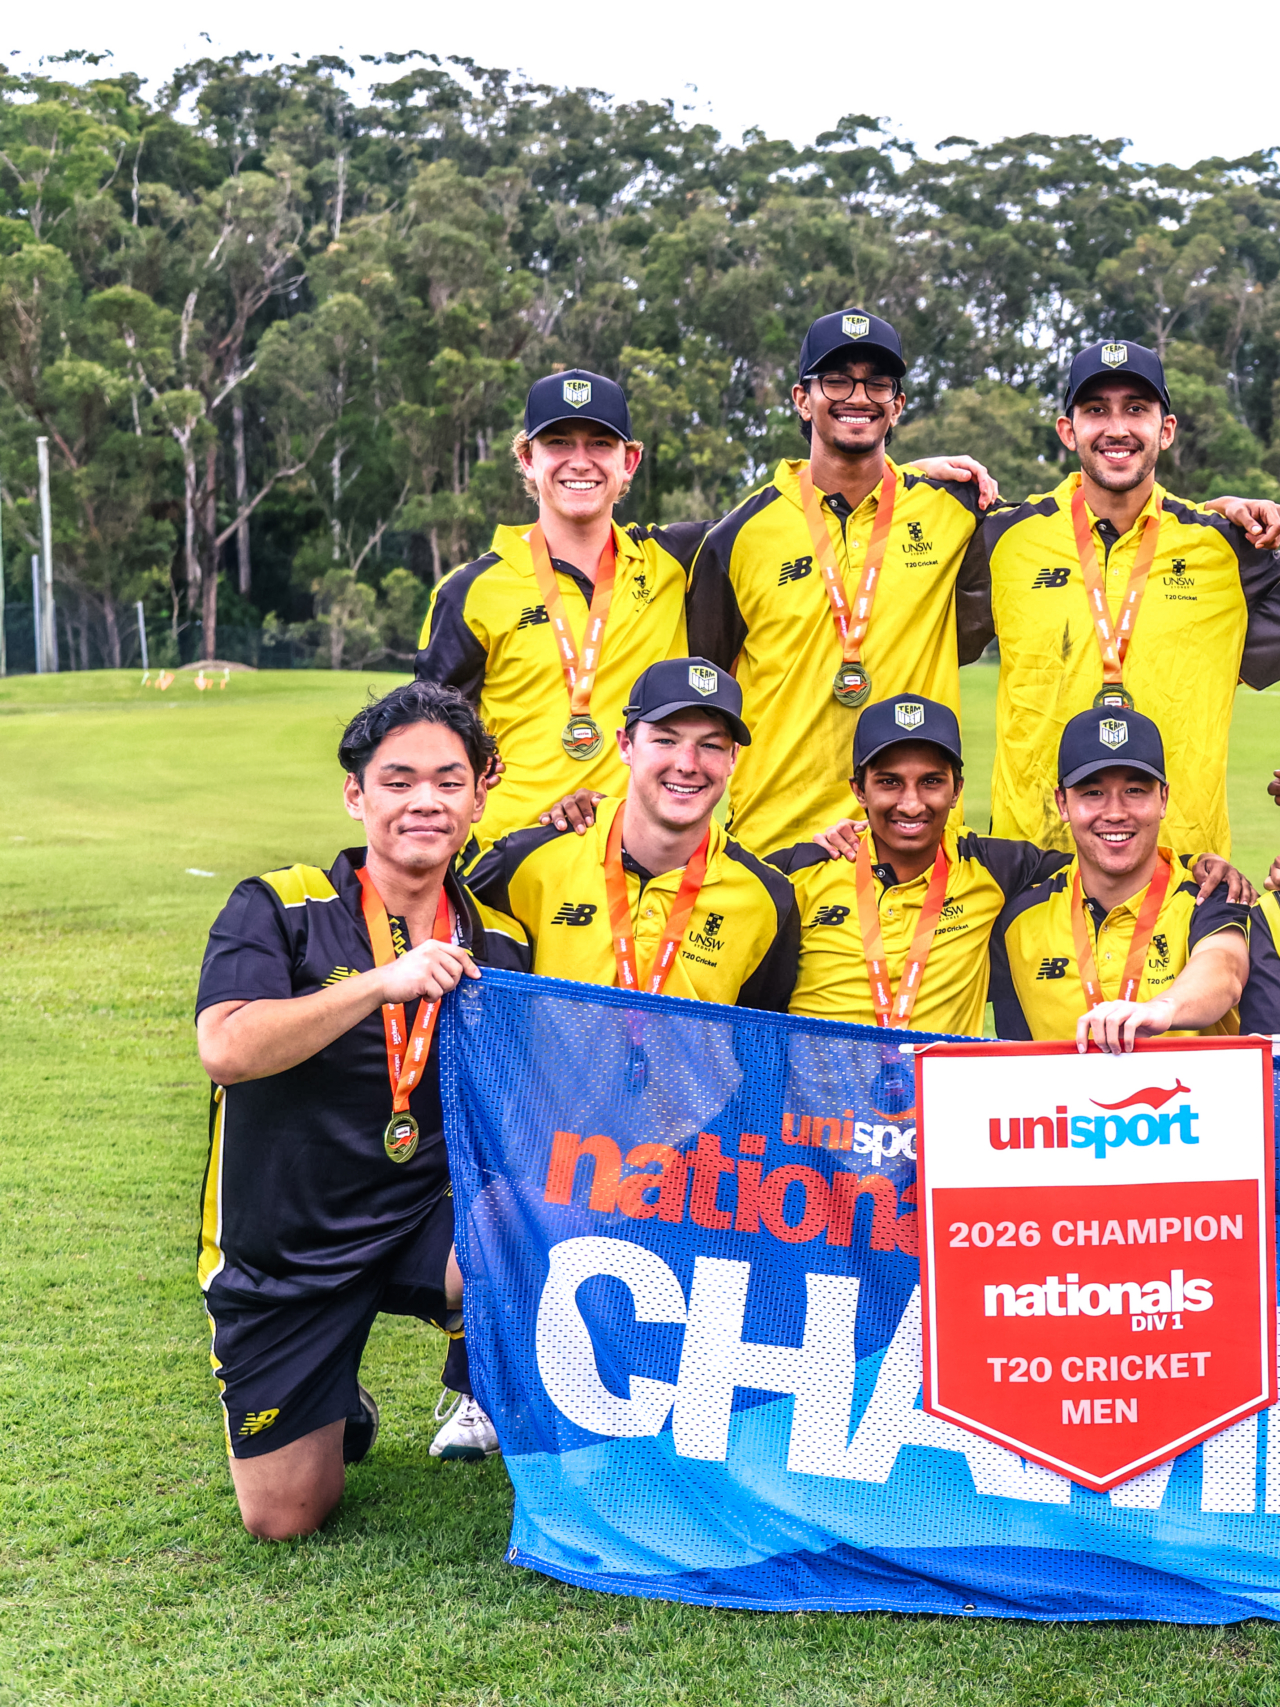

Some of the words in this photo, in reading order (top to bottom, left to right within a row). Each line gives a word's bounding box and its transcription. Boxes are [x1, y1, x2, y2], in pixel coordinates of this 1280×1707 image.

[1105, 343, 1124, 352] TEAM
[567, 382, 588, 391] TEAM
[902, 541, 933, 554] UNSW
[1163, 577, 1195, 586] UNSW
[692, 668, 715, 678] TEAM
[899, 705, 920, 713] TEAM
[1103, 722, 1124, 730] TEAM
[940, 904, 964, 918] NSW
[947, 924, 970, 932] Cricket
[688, 930, 725, 951] UNSW
[682, 950, 695, 961] T20
[696, 955, 718, 968] Cricket
[1149, 957, 1170, 969] UNS
[391, 1019, 402, 1045] unisport
[989, 1104, 1200, 1159] unisport
[948, 1219, 1041, 1249] 2026
[1051, 1214, 1244, 1246] CHAMPION
[984, 1269, 1214, 1318] nationals
[1131, 1315, 1167, 1332] DIV
[1171, 1314, 1184, 1330] 1
[987, 1356, 1053, 1383] T20
[1061, 1351, 1212, 1383] CRICKET
[1061, 1398, 1139, 1425] MEN
